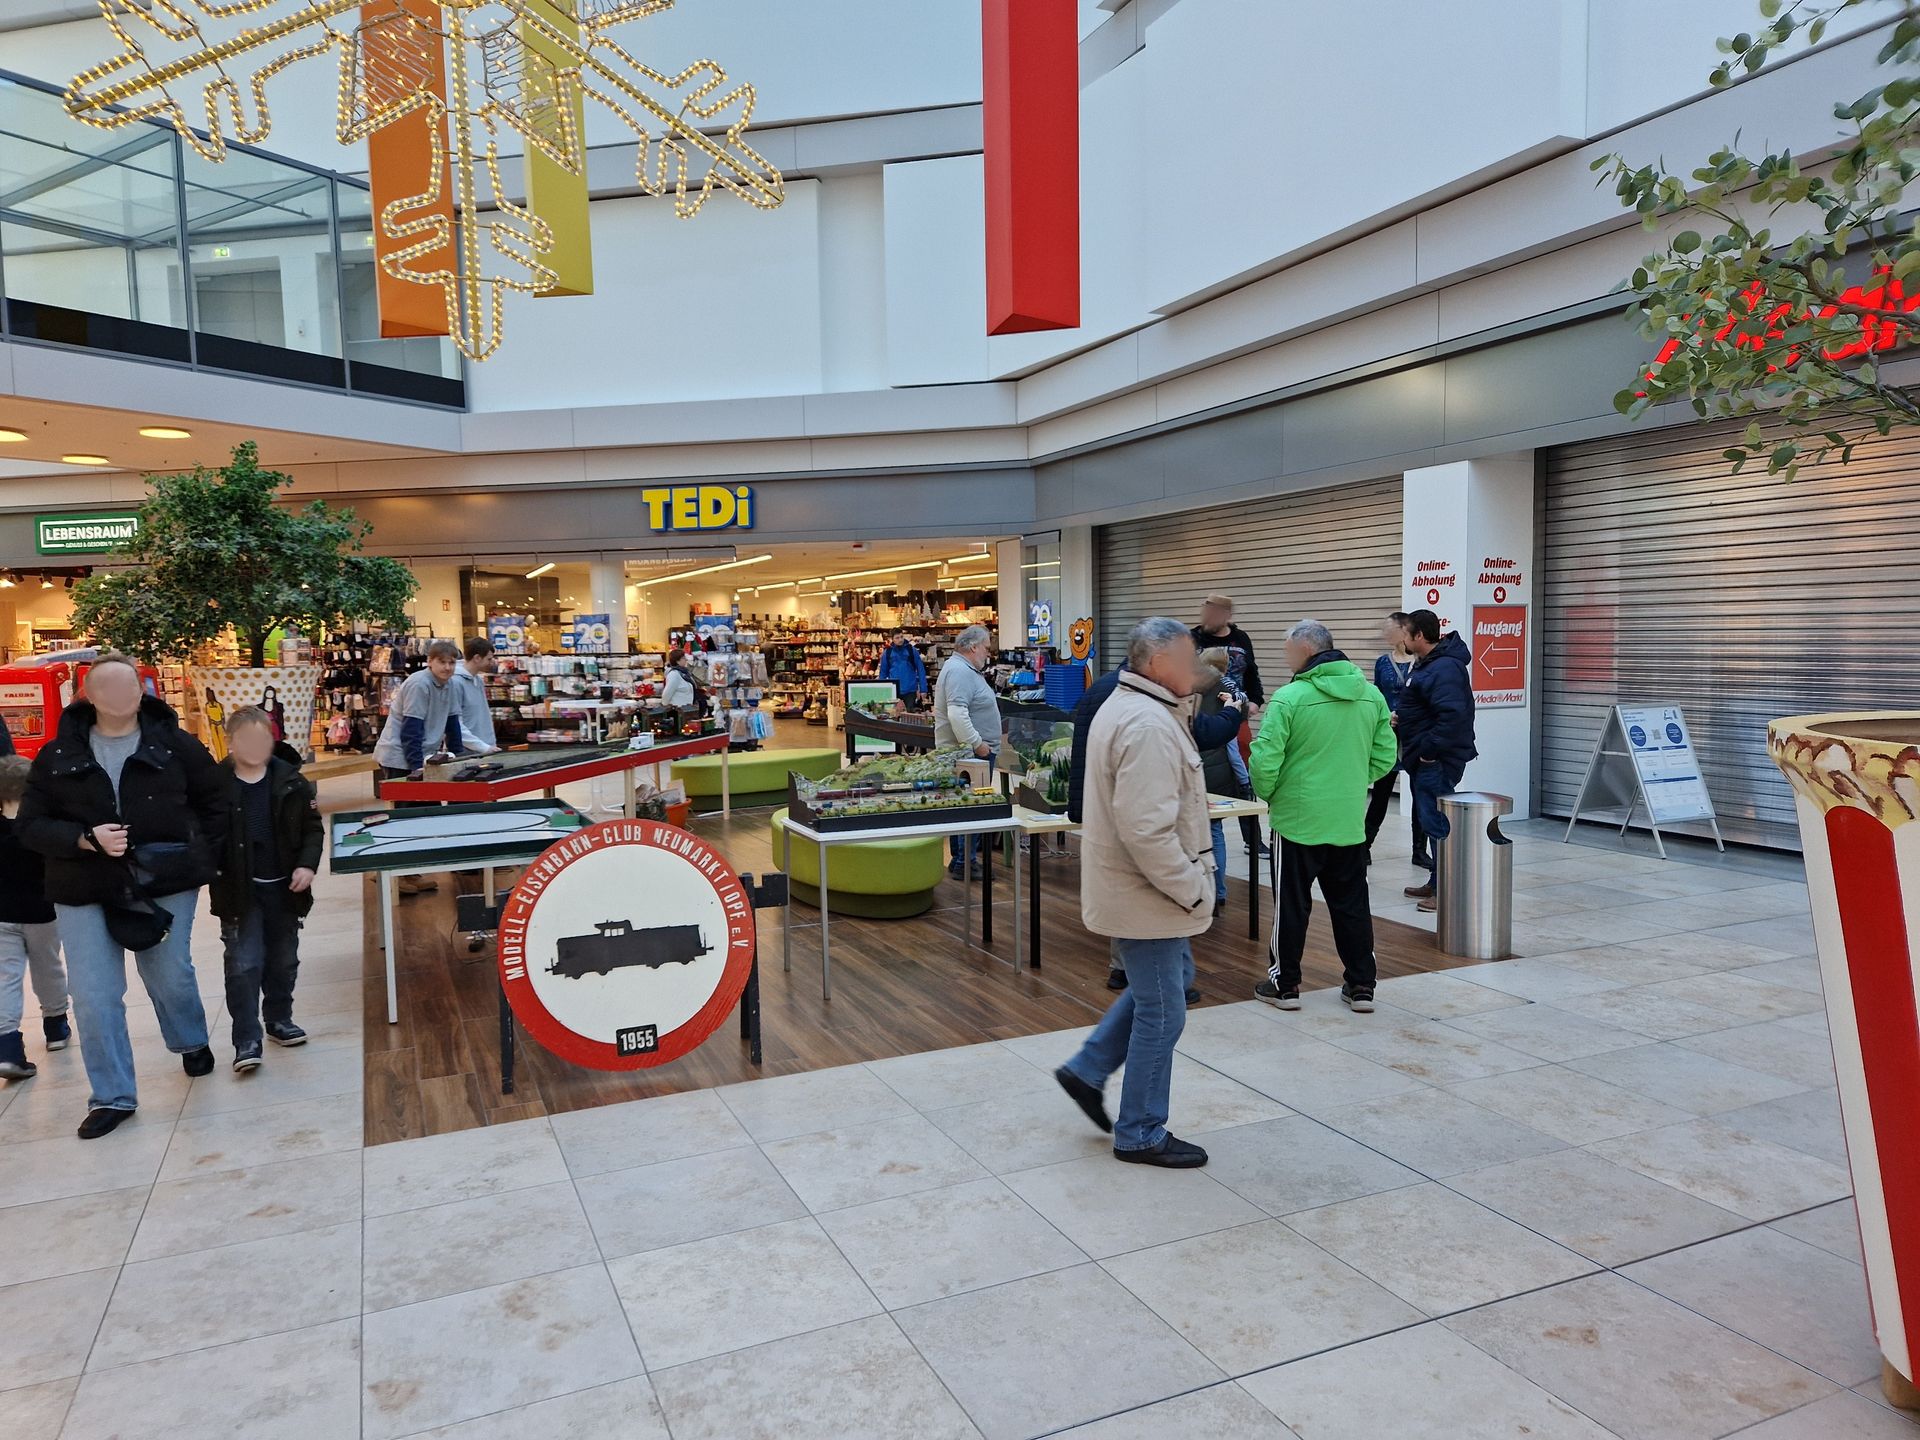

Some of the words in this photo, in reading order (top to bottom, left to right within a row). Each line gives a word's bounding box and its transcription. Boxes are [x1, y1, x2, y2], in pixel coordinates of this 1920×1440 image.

[642, 486, 750, 529] TEDi
[46, 525, 132, 541] LEBENSRAUM
[1418, 560, 1450, 572] Online-
[1484, 557, 1516, 569] Online-
[1412, 573, 1456, 587] Abholung
[1478, 572, 1522, 586] Abholung
[576, 623, 609, 645] 20
[1475, 620, 1523, 638] Ausgang
[576, 644, 609, 654] JAHRE
[620, 1030, 654, 1051] 1955
